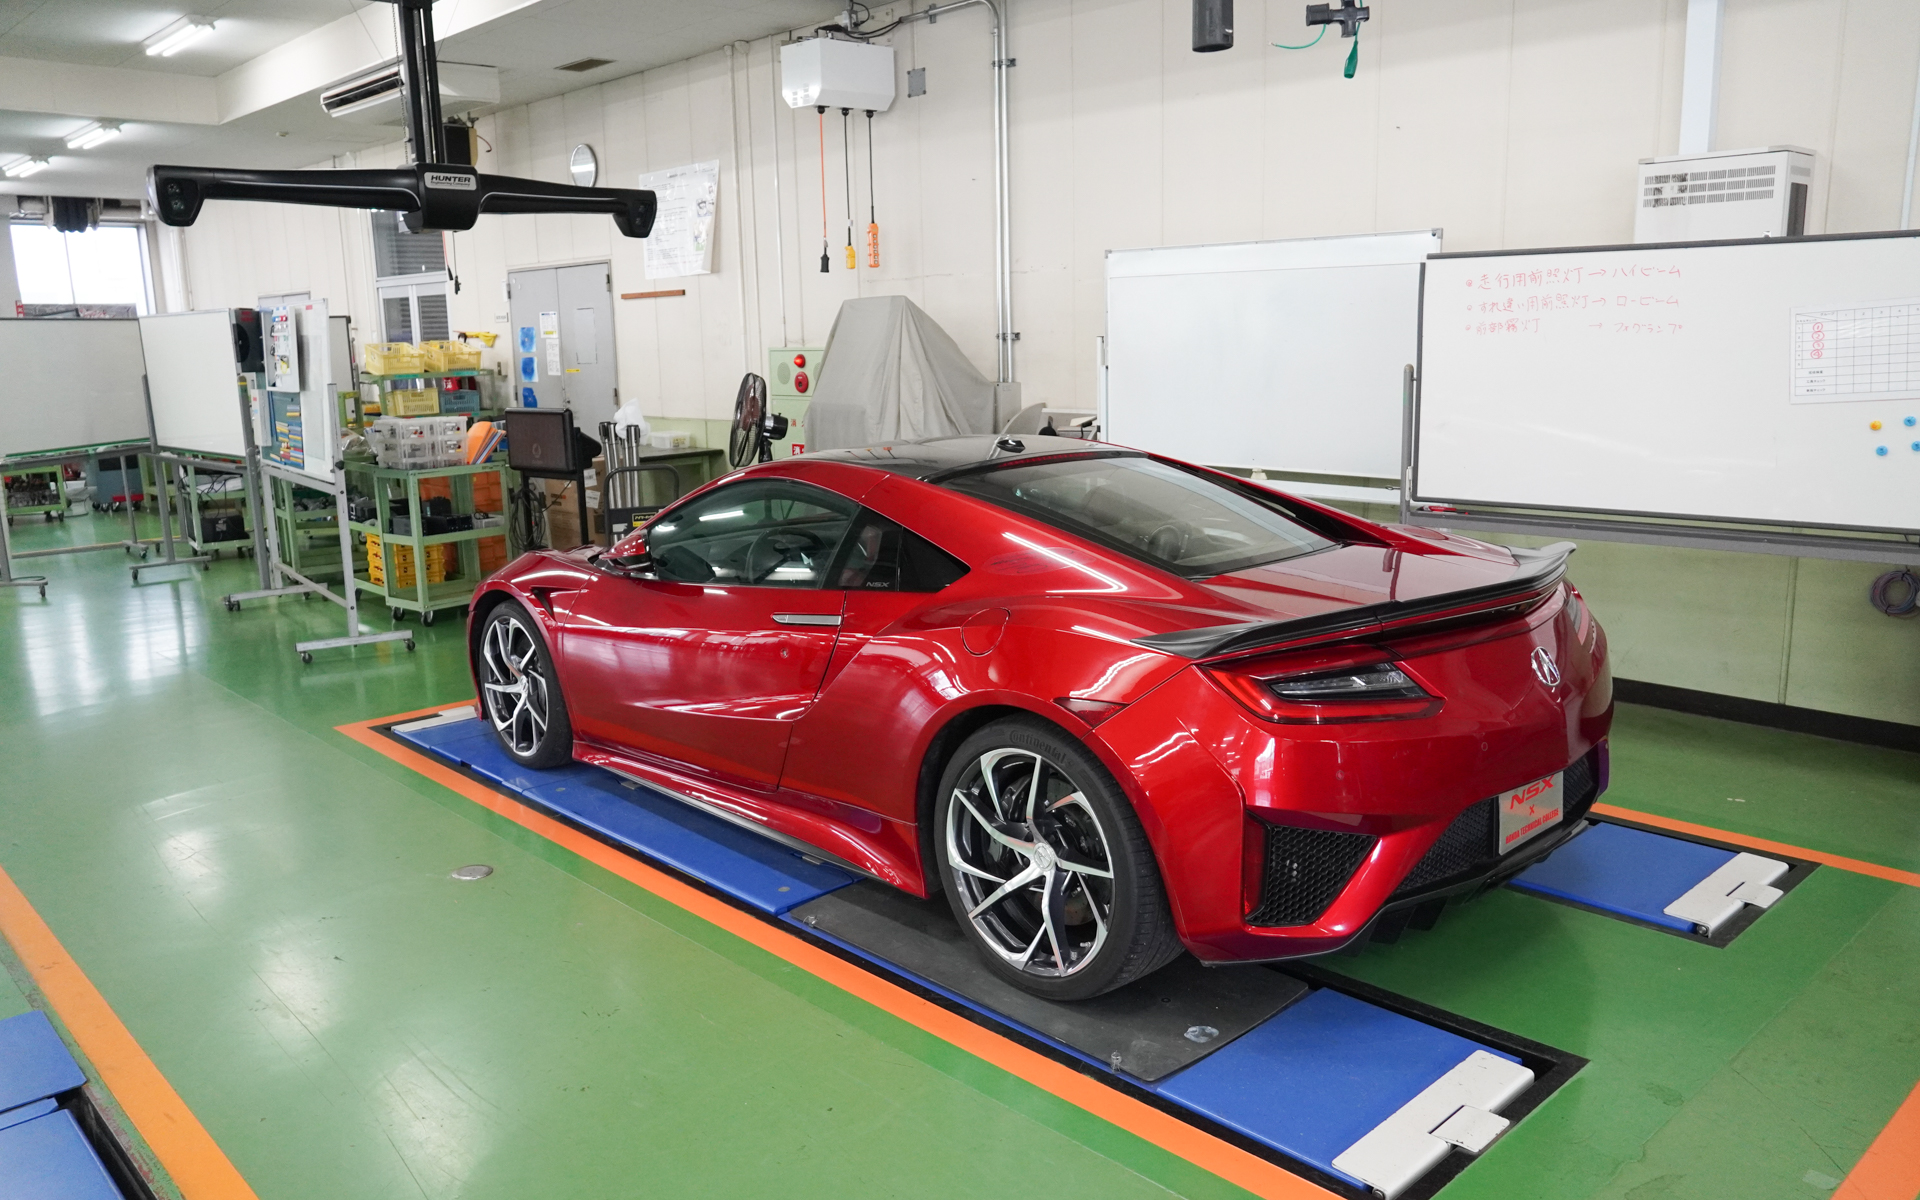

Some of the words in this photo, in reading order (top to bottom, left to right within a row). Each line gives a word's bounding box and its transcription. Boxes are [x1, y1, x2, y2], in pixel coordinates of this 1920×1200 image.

[430, 175, 471, 183] HUNTER
[1009, 729, 1067, 764] Continental
[1510, 774, 1555, 810] NSX
[1520, 817, 1542, 836] TECHNICAL
[1542, 807, 1559, 824] COLLEGE
